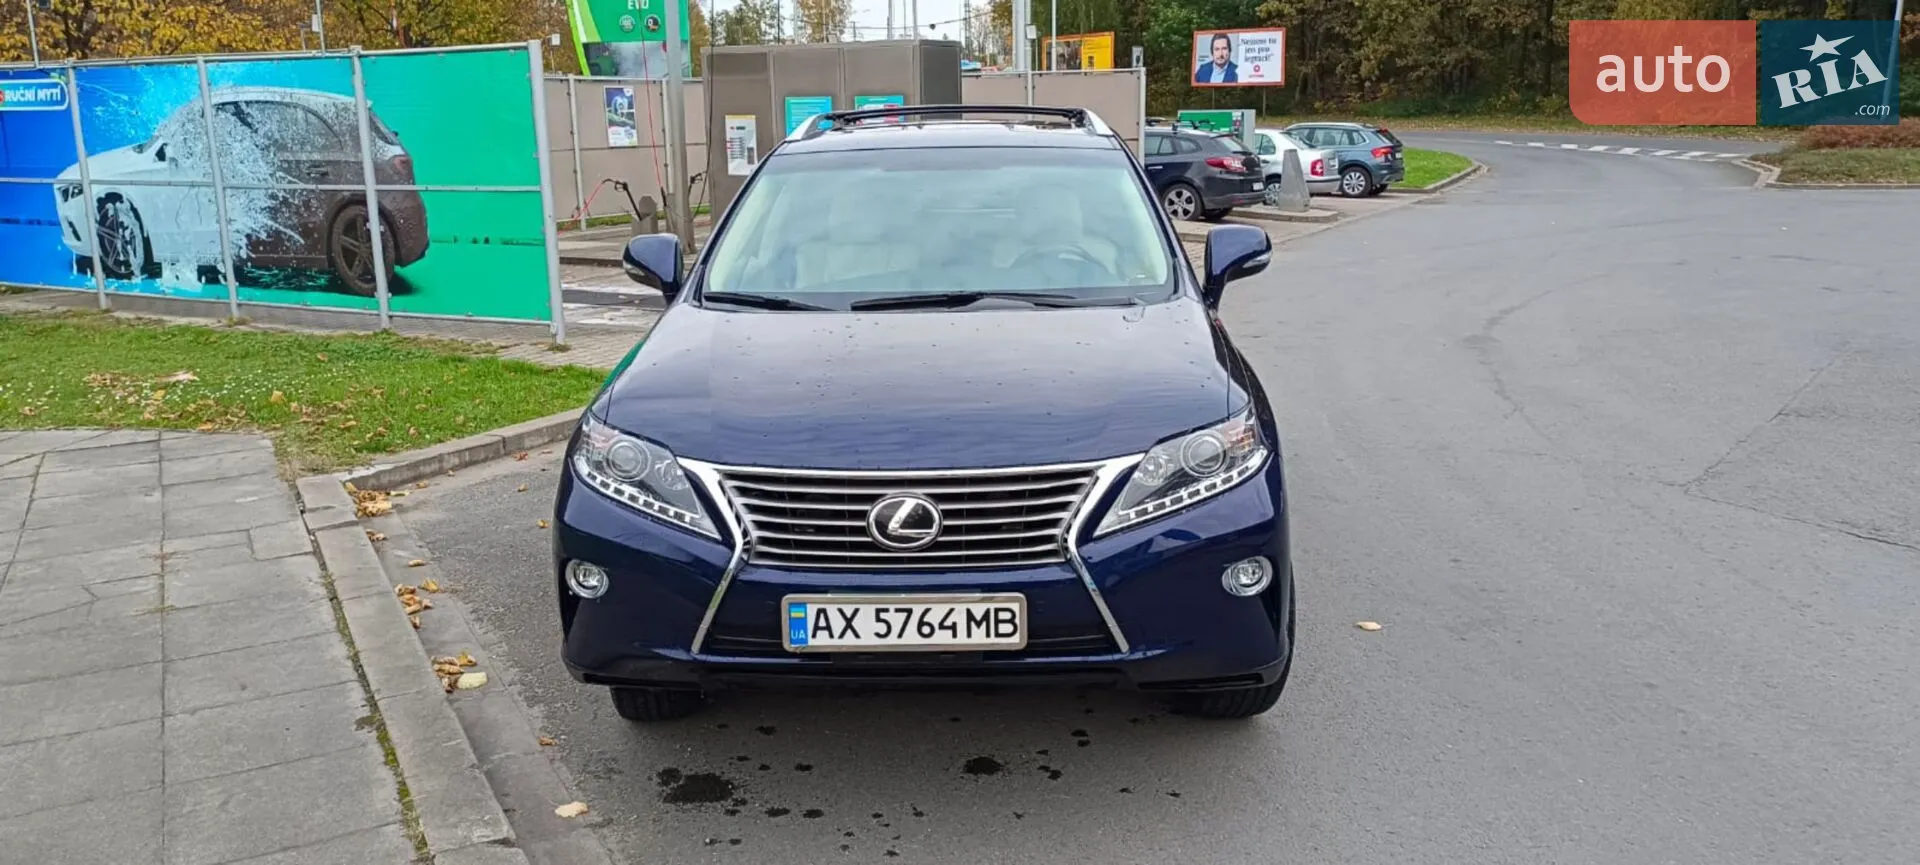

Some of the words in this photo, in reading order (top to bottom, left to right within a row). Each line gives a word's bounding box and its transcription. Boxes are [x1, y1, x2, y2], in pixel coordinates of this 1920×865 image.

[811, 607, 862, 640] AX
[873, 607, 958, 640] 5764
[966, 607, 1019, 639] MB
[790, 630, 806, 640] UA
